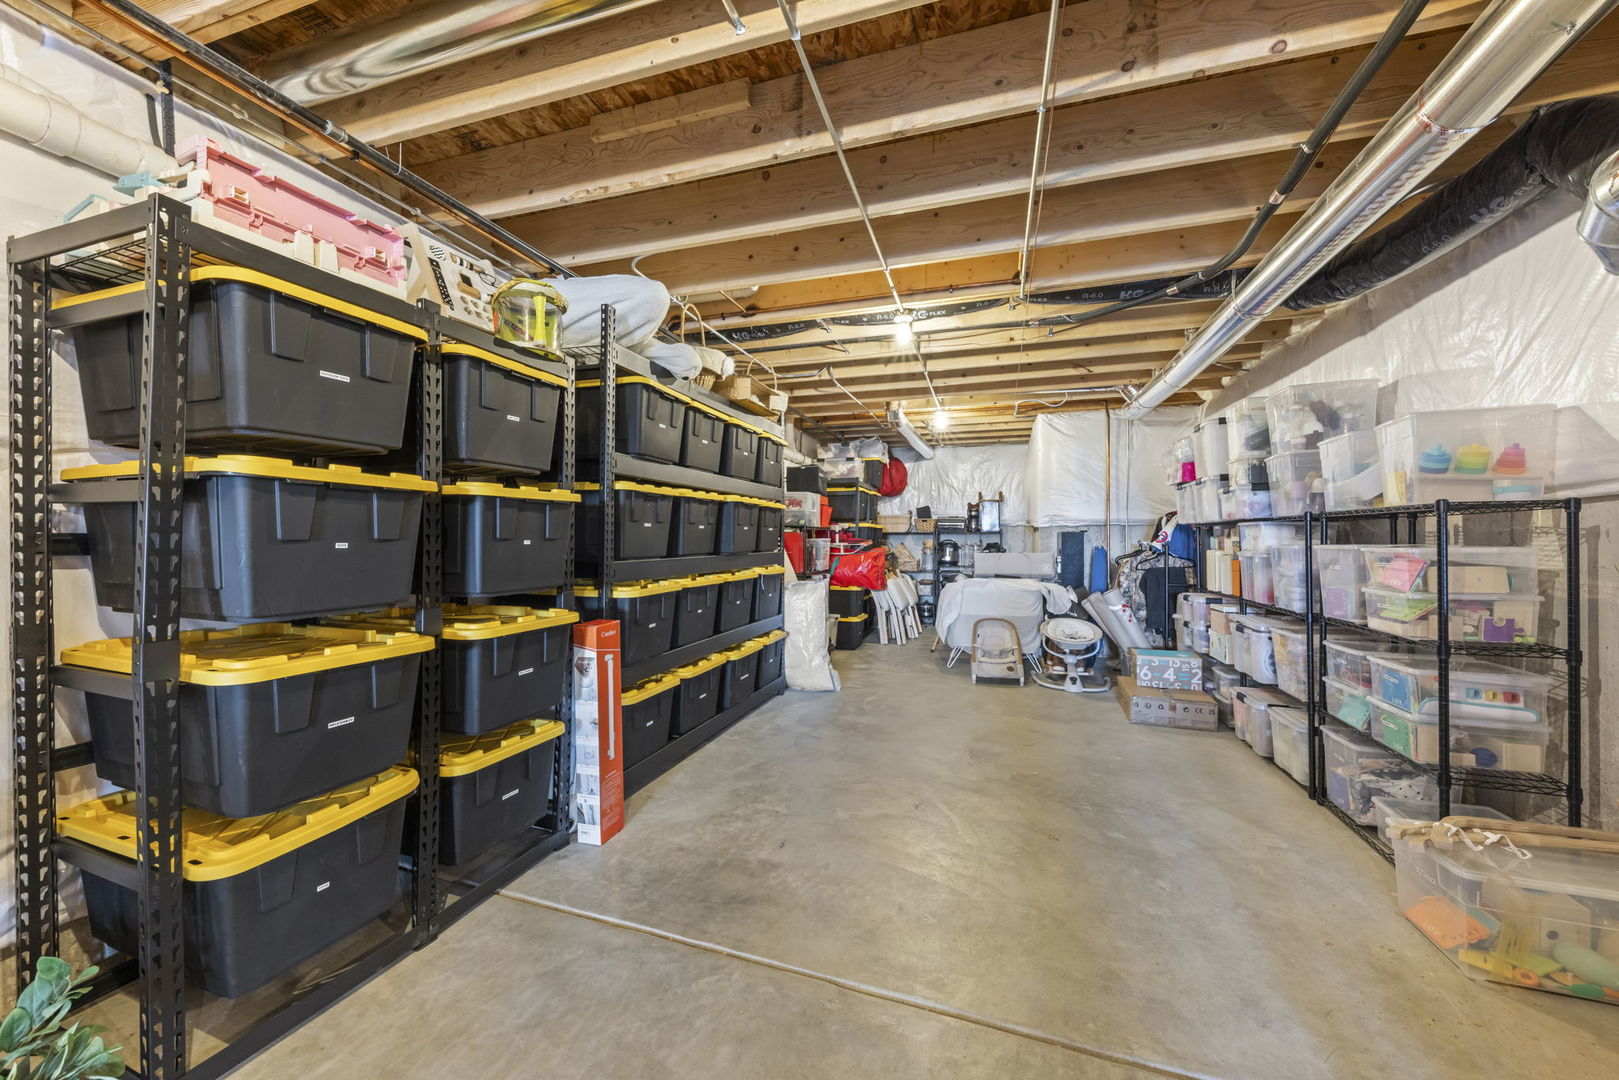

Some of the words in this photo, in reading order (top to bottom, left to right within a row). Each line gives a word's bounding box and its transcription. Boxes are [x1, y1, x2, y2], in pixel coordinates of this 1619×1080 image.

[876, 313, 895, 321] R-6.0
[1140, 666, 1152, 680] 6
[1163, 667, 1177, 682] 4
[1191, 669, 1202, 684] 2
